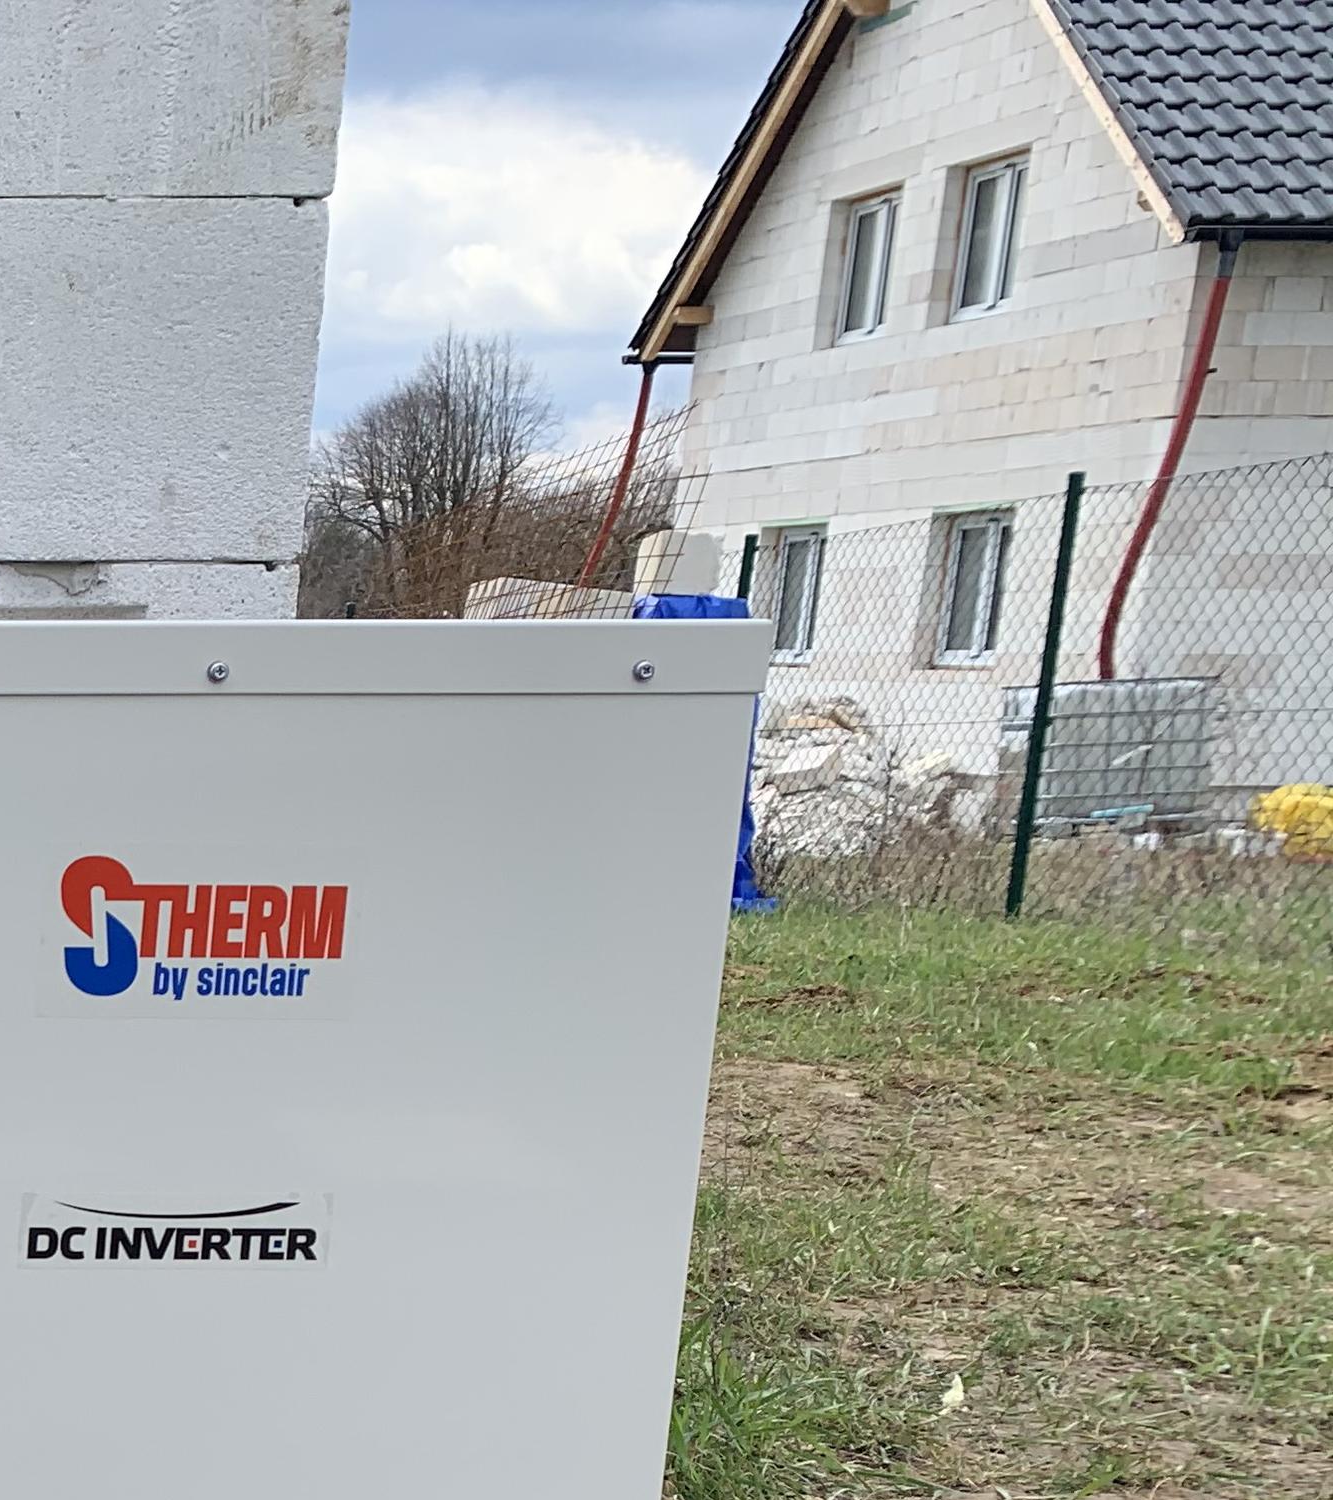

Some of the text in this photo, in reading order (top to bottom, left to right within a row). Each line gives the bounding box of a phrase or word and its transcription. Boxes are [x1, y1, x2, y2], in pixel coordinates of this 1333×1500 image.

[153, 962, 310, 1000] by sinclair
[27, 1227, 317, 1261] DC INVERTER
